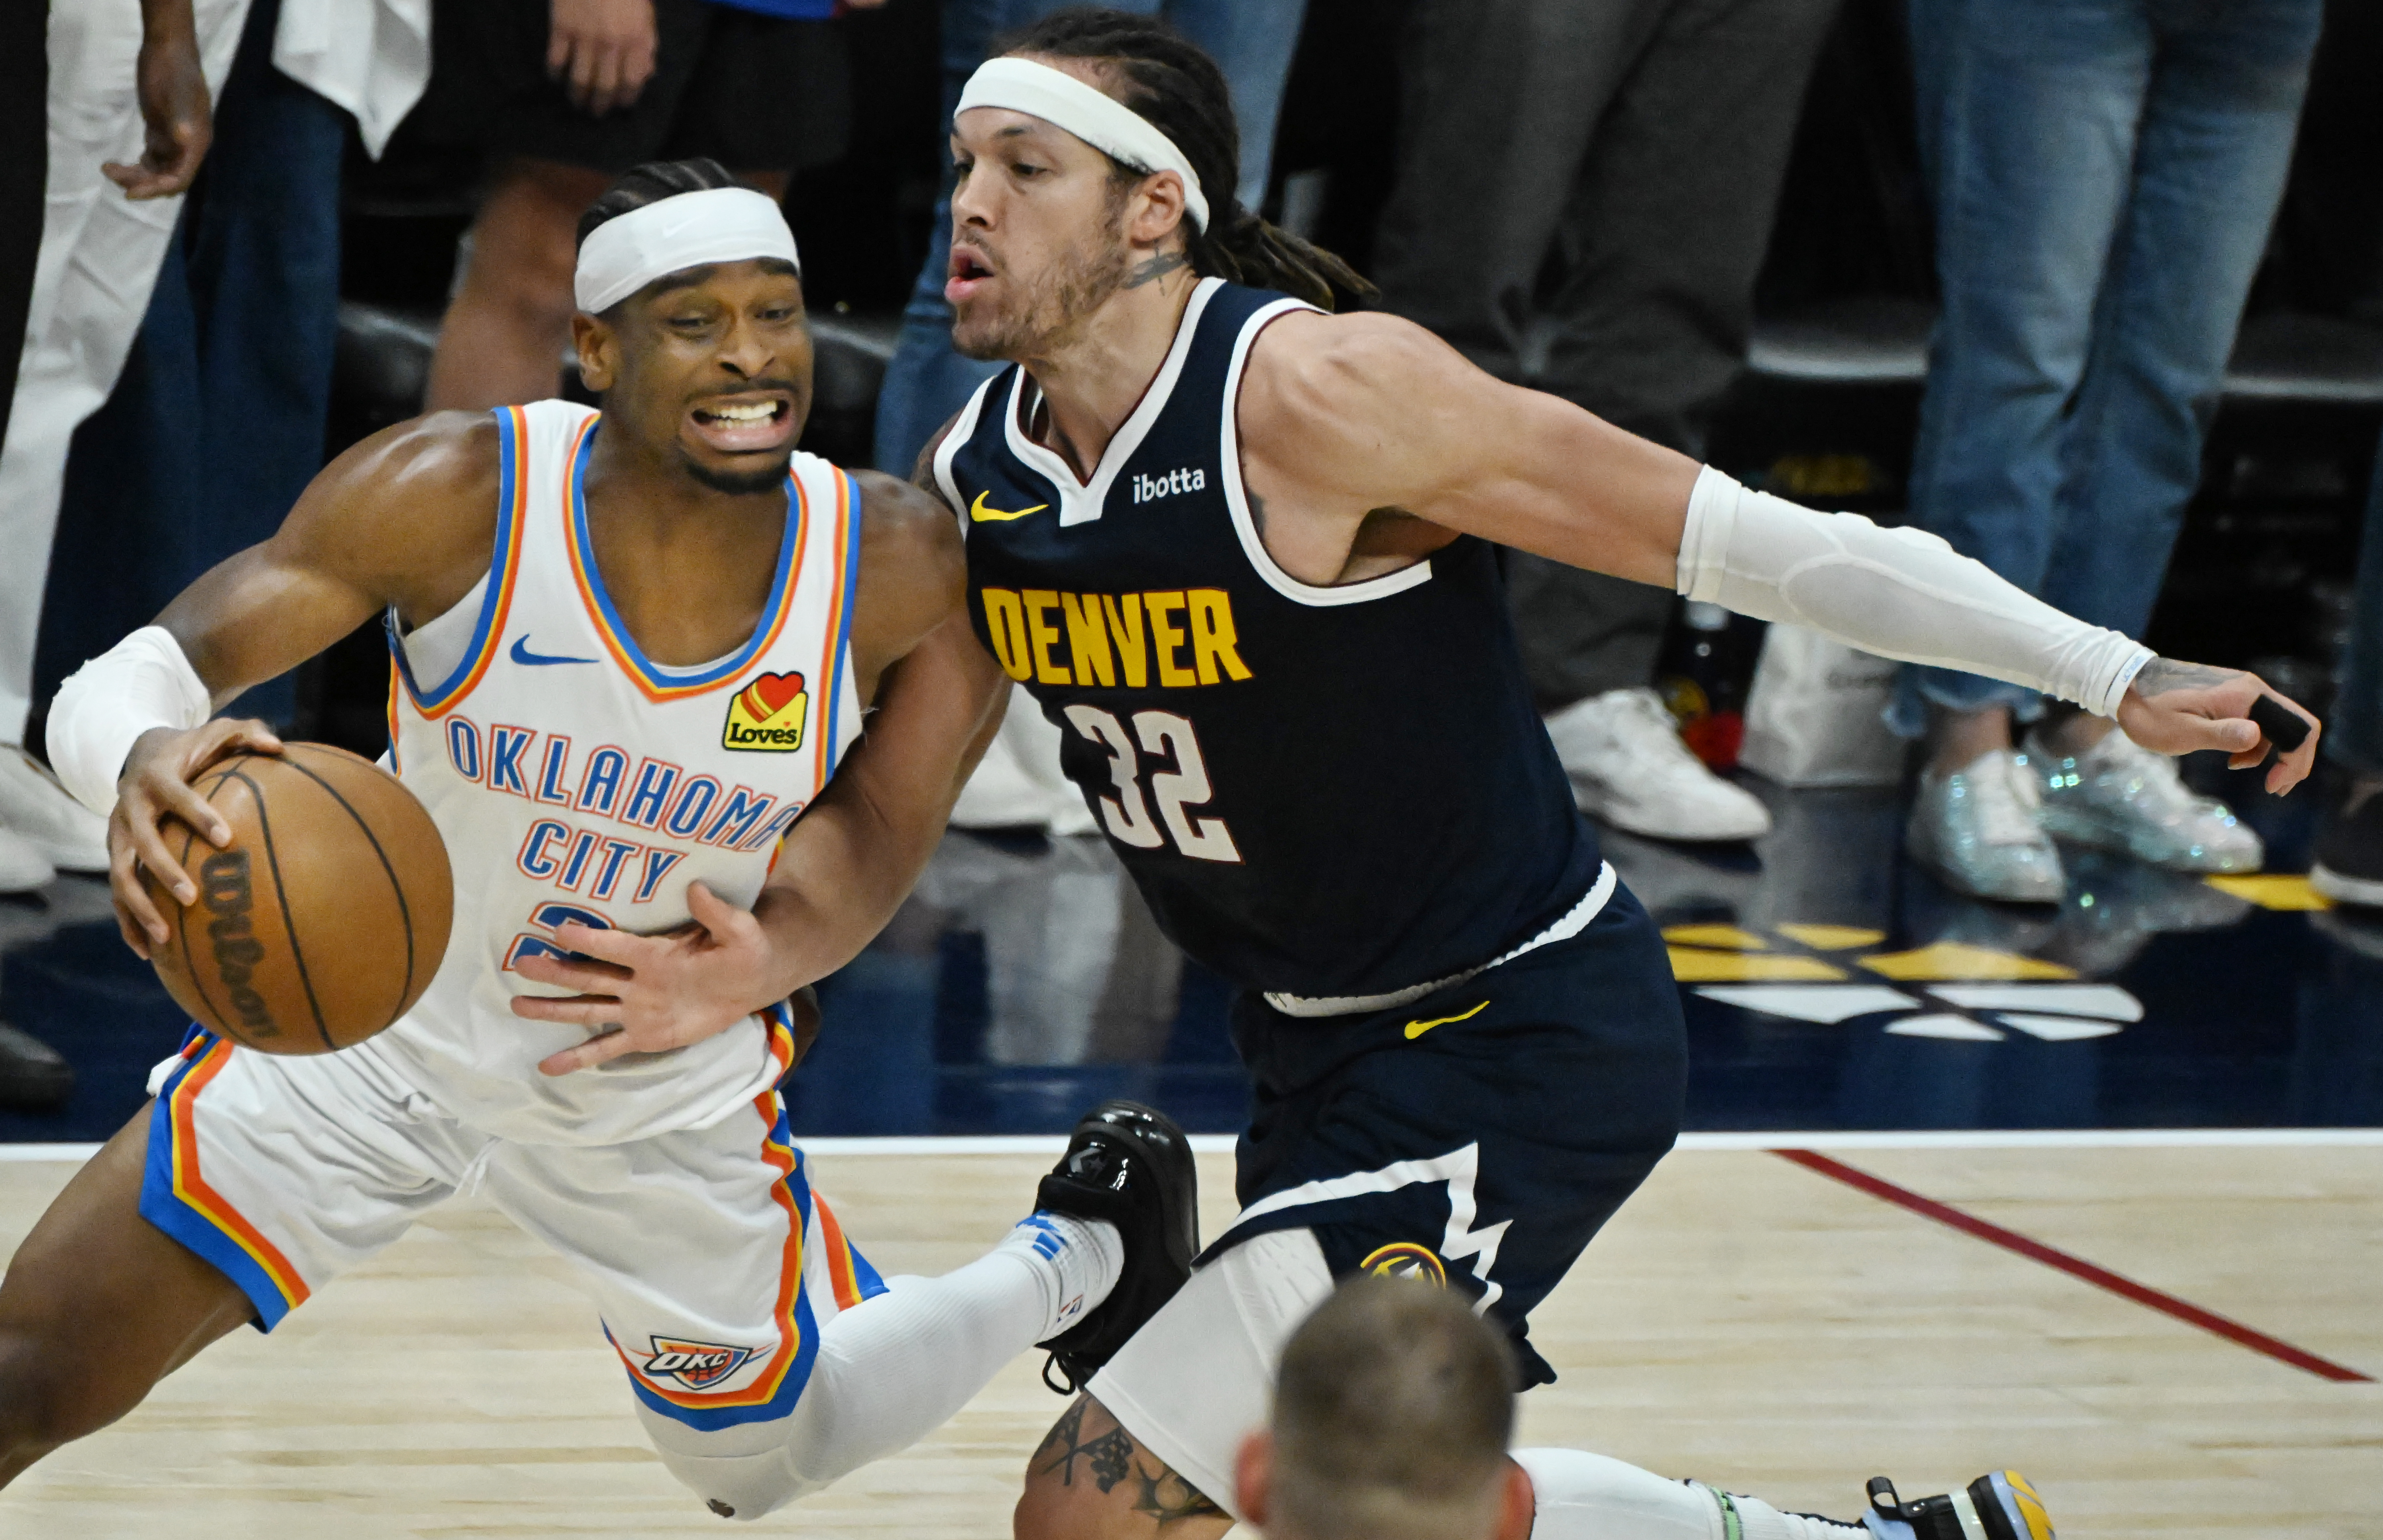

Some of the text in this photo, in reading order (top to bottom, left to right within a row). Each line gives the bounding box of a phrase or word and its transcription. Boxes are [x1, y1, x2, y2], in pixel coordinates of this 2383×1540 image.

[1133, 467, 1205, 504] ibotta
[981, 587, 1254, 688] DENVER
[445, 715, 805, 852] OKLAHOMA
[1063, 704, 1246, 865] 32
[517, 818, 690, 904] CITY
[645, 1352, 730, 1371] OKC
